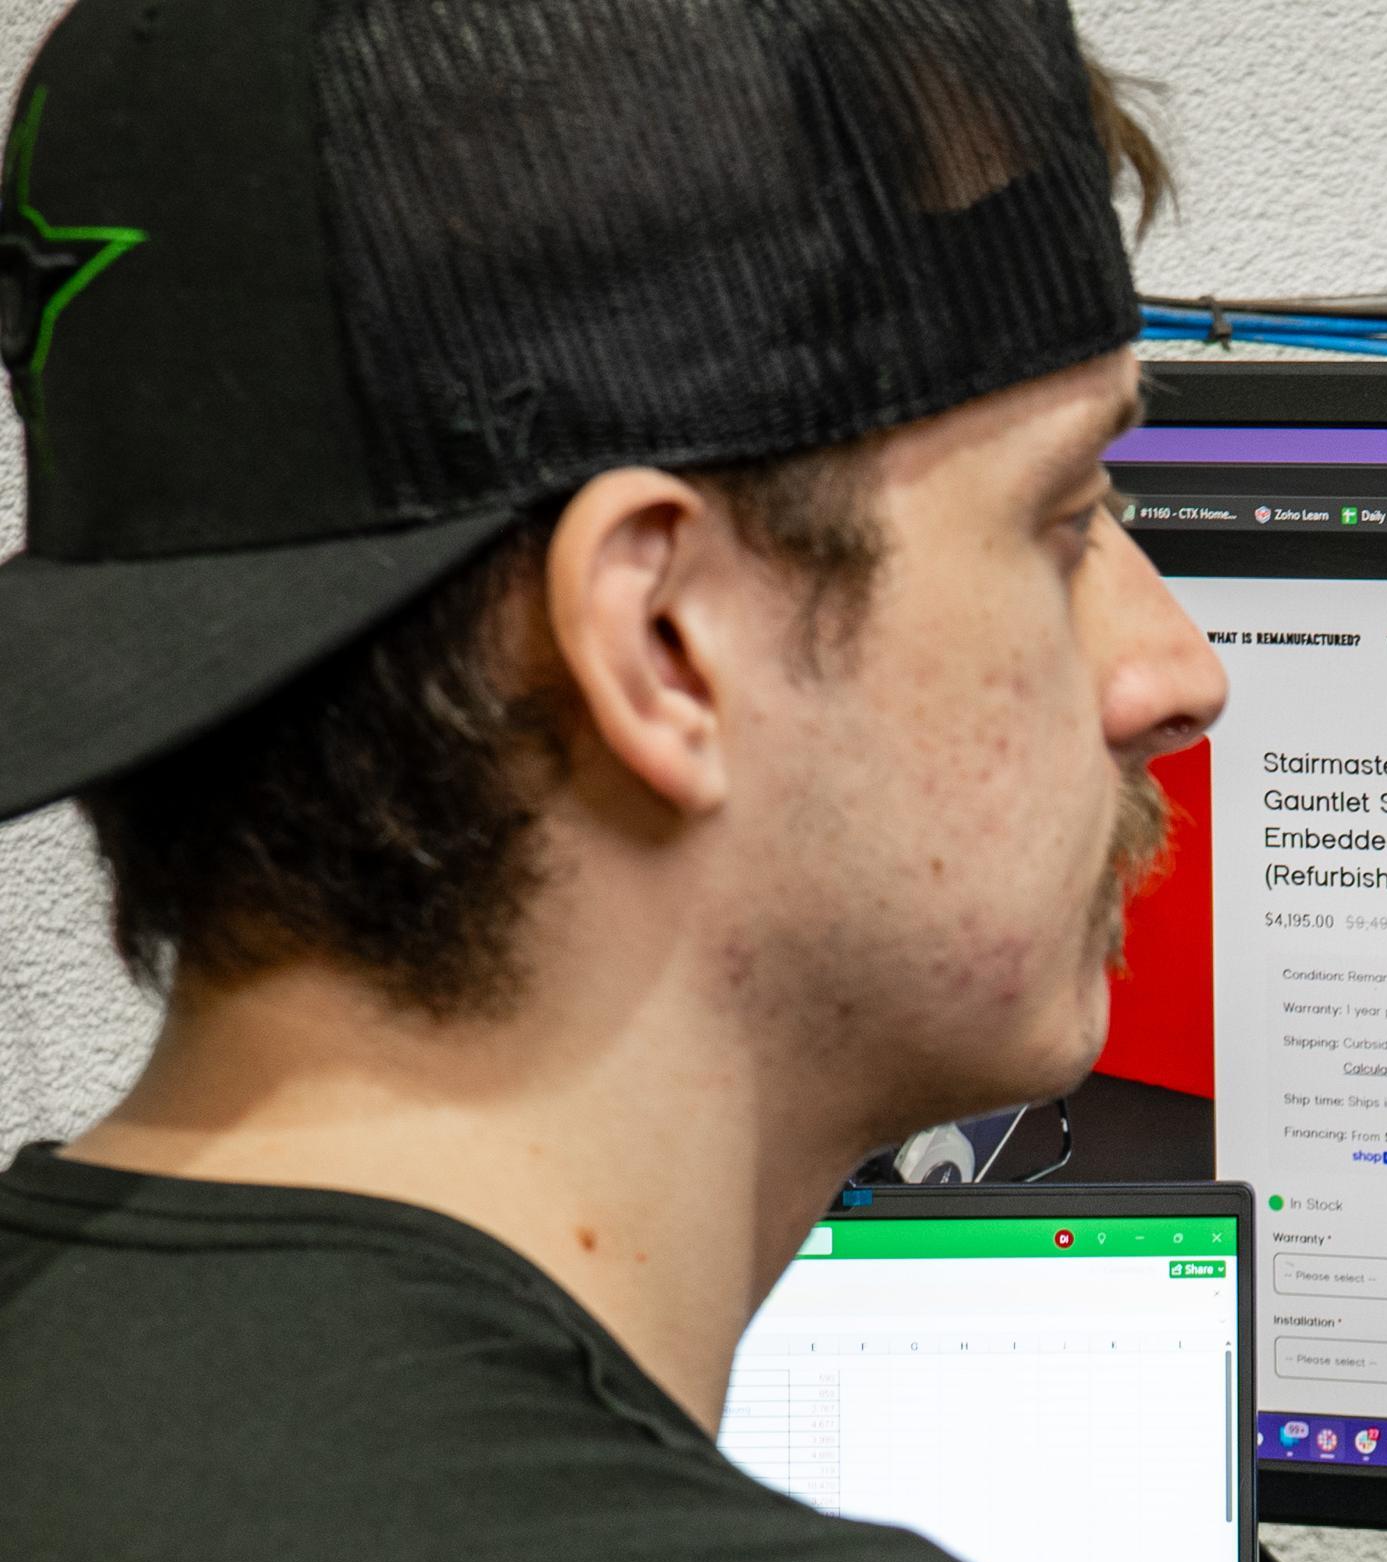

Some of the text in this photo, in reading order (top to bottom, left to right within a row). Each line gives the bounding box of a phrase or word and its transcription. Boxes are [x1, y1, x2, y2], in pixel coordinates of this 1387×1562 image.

[1275, 509, 1328, 521] Zoho Learn
[1362, 510, 1385, 524] Daily
[1207, 632, 1360, 646] WHAT IS REMANUFACTURED?
[1264, 790, 1370, 813] Gauntlet
[1265, 912, 1334, 929] $4,195.00
[1283, 969, 1344, 982] Condition:
[1283, 1002, 1342, 1016] Warranty:
[1355, 1006, 1380, 1018] year
[1284, 1035, 1339, 1050] Shipping:
[1284, 1093, 1310, 1106] Ship
[1315, 1094, 1344, 1106] time:
[1348, 1095, 1379, 1109] Ships
[1284, 1126, 1347, 1141] Financing:
[1351, 1130, 1380, 1142] From
[1353, 1150, 1381, 1163] shop
[1290, 1198, 1342, 1211] In Stock
[1273, 1233, 1324, 1245] Warranty
[1185, 1264, 1213, 1275] Share
[1296, 1271, 1364, 1283] Please select
[1274, 1315, 1335, 1328] Installation
